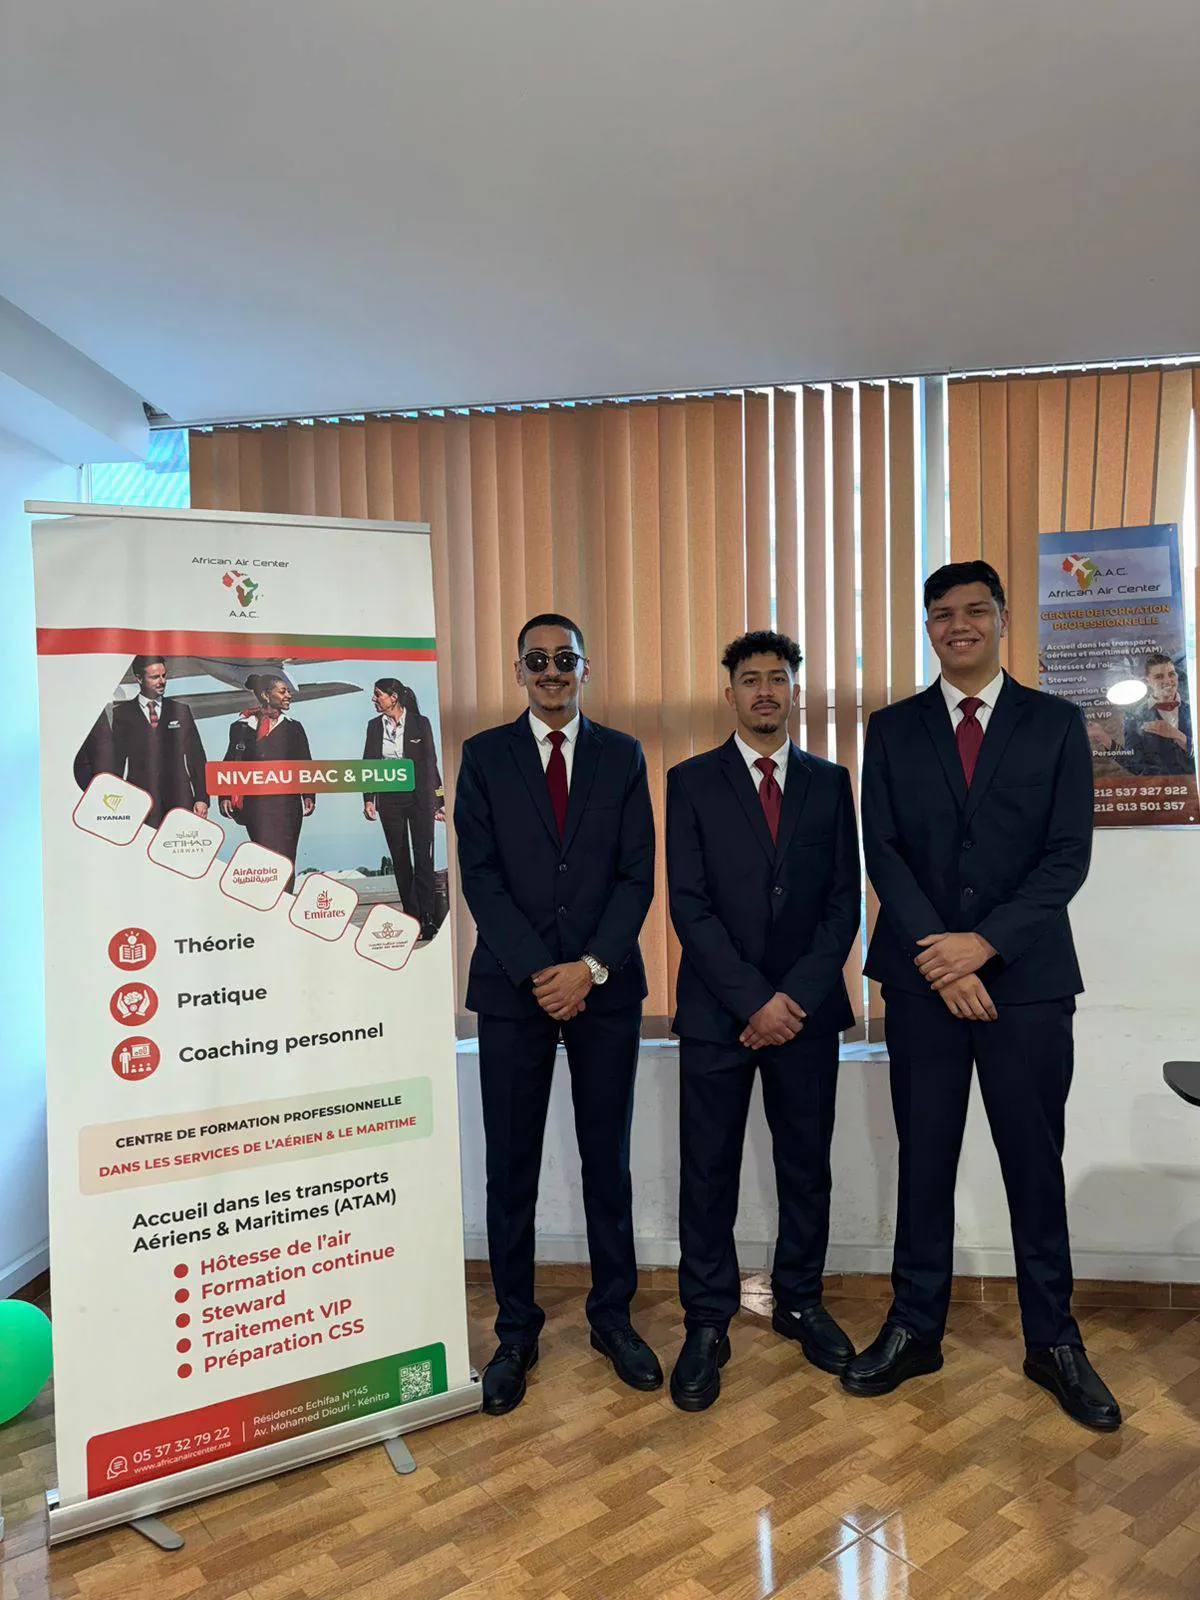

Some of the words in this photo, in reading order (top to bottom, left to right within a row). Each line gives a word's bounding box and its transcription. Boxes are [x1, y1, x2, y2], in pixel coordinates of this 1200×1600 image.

[192, 557, 232, 565] African
[253, 560, 290, 568] Center
[1094, 568, 1128, 577] A.A.C.
[1048, 588, 1093, 599] African
[1097, 587, 1113, 595] Air
[1118, 584, 1161, 594] Center
[1040, 610, 1086, 621] CENTRE
[1087, 608, 1101, 618] DE
[1103, 603, 1169, 617] FORMATION
[1052, 616, 1159, 631] PROFESSIONNELLE
[1046, 643, 1076, 651] Accueil
[1077, 641, 1097, 650] dans
[1111, 639, 1156, 647] transports
[1131, 645, 1162, 654] (ATAM)
[1048, 676, 1087, 684] Stewards
[1092, 749, 1135, 757] Personnel
[217, 770, 293, 785] NIVEAU
[299, 769, 338, 783] BAC
[343, 769, 356, 782] &
[361, 768, 408, 782] PLUS
[1094, 788, 1113, 797] 212
[1115, 787, 1137, 796] 537
[1140, 787, 1161, 796] 327
[1164, 786, 1188, 795] 922
[1094, 803, 1114, 812] 212
[1116, 802, 1138, 811] 613
[1140, 802, 1161, 811] 501
[1163, 801, 1185, 810] 357
[163, 839, 212, 848] ETIHAD
[233, 868, 278, 876] AirArabia
[304, 909, 346, 920] Emirates
[174, 934, 256, 955] Théorie
[177, 986, 268, 1009] Pratique
[178, 1037, 279, 1063] Coaching
[285, 1022, 384, 1052] personnel
[115, 1131, 173, 1149] CENTRE
[176, 1128, 196, 1140] DE
[200, 1114, 280, 1137] FORMATION
[284, 1095, 402, 1123] PROFESSIONNELLE
[99, 1161, 141, 1178] DANS
[145, 1157, 170, 1170] LES
[174, 1145, 240, 1166] SERVICES
[243, 1142, 261, 1155] DE
[326, 1130, 335, 1141] &
[338, 1127, 353, 1138] LE
[356, 1116, 417, 1135] MARITIME
[132, 1202, 208, 1230] Accueil
[213, 1195, 260, 1215] dans
[265, 1189, 291, 1206] les
[296, 1171, 389, 1199] transports
[132, 1227, 211, 1253] Aériens
[216, 1221, 230, 1237] &
[235, 1203, 330, 1233] Maritimes
[334, 1188, 397, 1217] (ATAM)
[201, 1246, 281, 1275] Hôtesse
[287, 1240, 312, 1257] de
[201, 1265, 306, 1300] Formation
[312, 1245, 395, 1275] continue
[202, 1289, 286, 1324] Steward
[202, 1308, 315, 1348] Traitement
[320, 1298, 353, 1319] VIP
[204, 1334, 323, 1373] Préparation
[329, 1318, 365, 1340] CSS
[253, 1404, 304, 1426] Résidence
[306, 1394, 340, 1411] Echifaa
[254, 1428, 269, 1438] Av.
[271, 1411, 320, 1433] Mohamed
[322, 1402, 350, 1418] Diouri
[358, 1391, 391, 1407] Kénitra
[133, 1449, 152, 1464] 05
[155, 1443, 172, 1458] 37
[174, 1438, 192, 1453] 32
[194, 1432, 212, 1447] 79
[214, 1426, 231, 1441] 22
[133, 1441, 232, 1474] www.africanaircenter.ma
